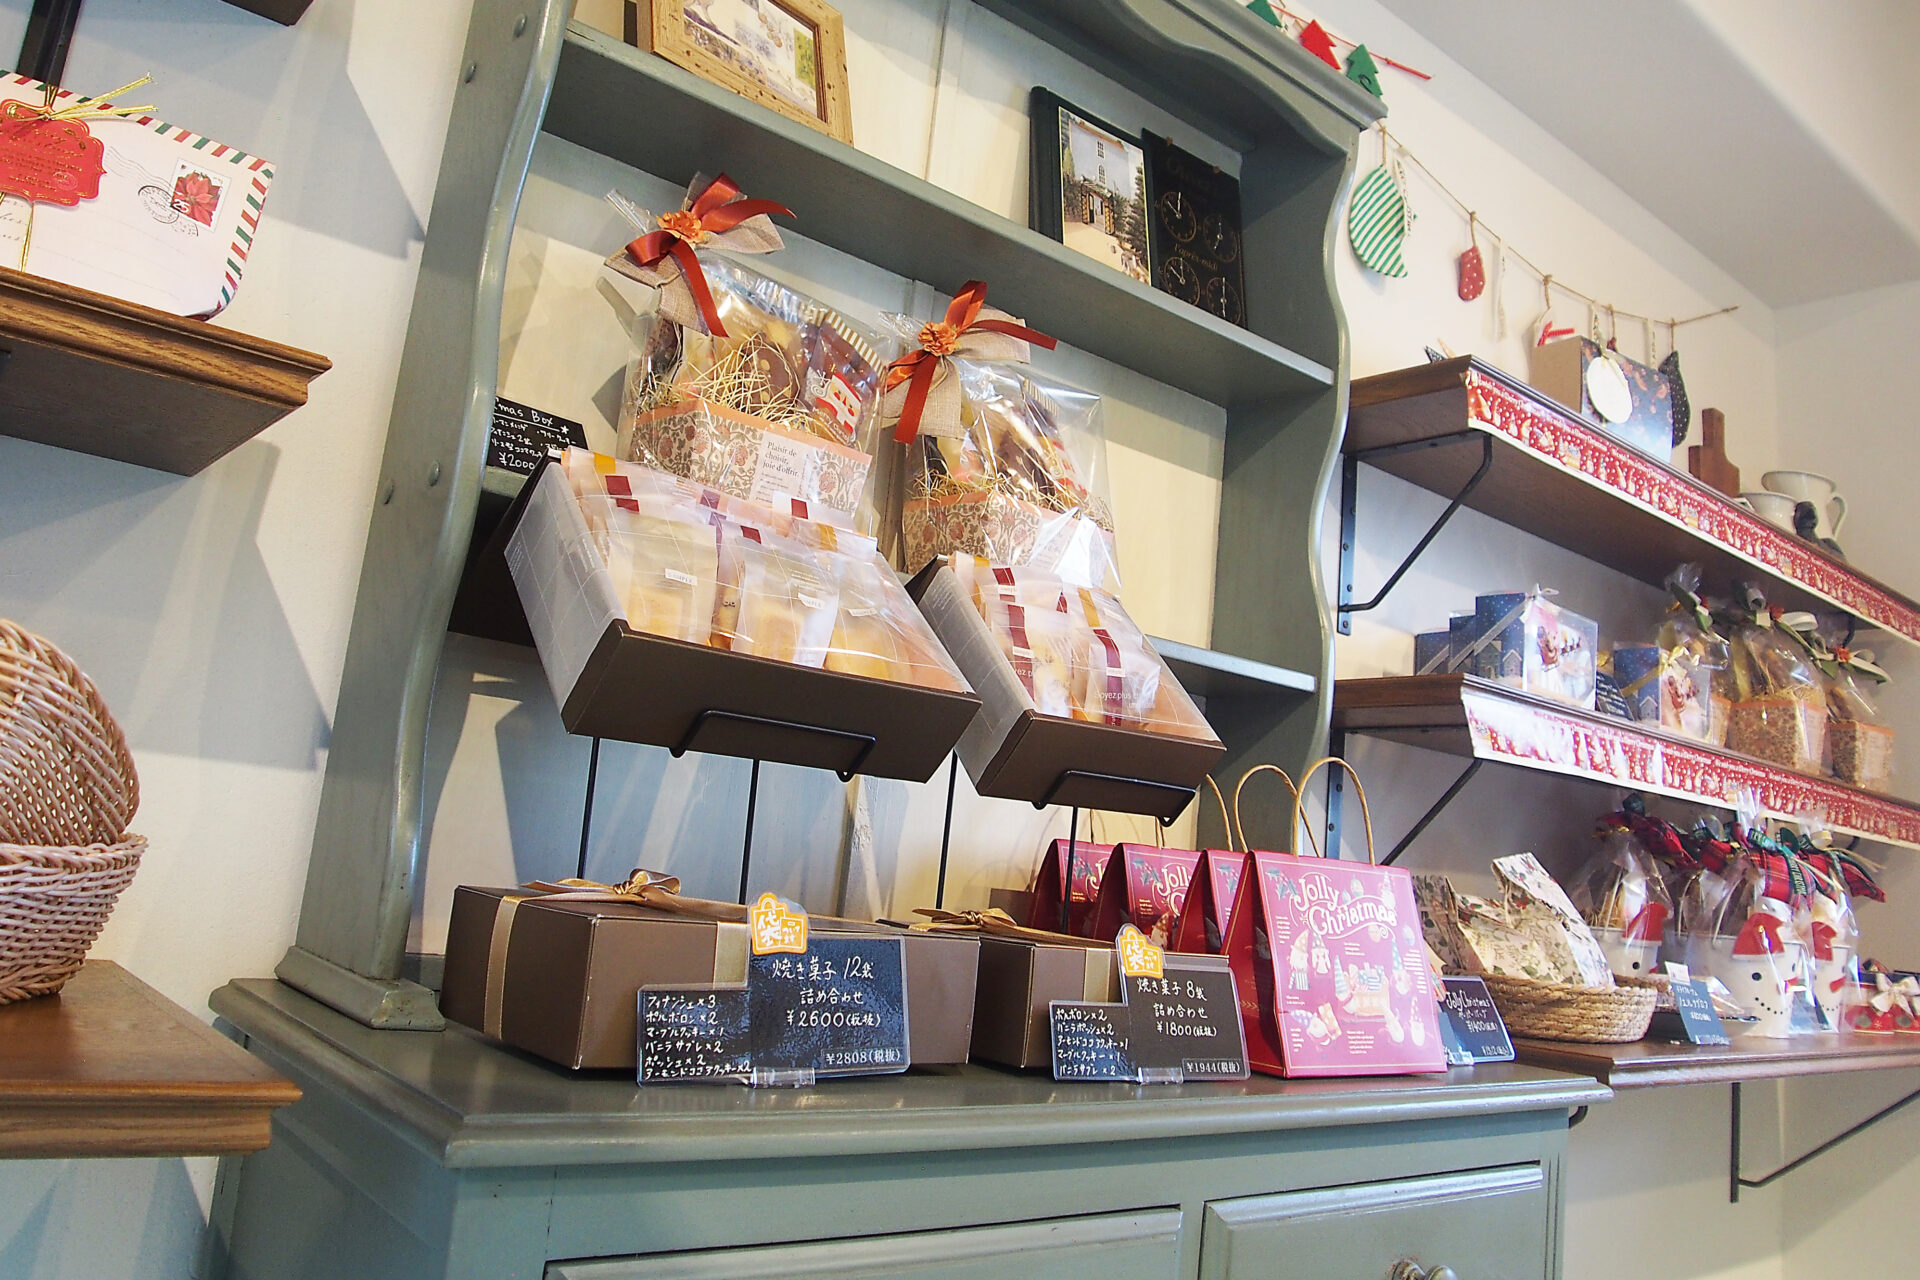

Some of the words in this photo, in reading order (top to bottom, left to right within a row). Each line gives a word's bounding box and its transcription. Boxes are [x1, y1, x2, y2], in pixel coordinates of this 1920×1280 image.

[173, 198, 190, 213] 25
[531, 409, 554, 427] Box
[767, 441, 788, 454] Plaisir
[788, 448, 798, 457] de
[762, 460, 776, 470] joie
[1157, 866, 1191, 896] Joll
[1294, 875, 1340, 911] Jolly
[1308, 901, 1398, 936] Christmas
[772, 956, 837, 981] 焼き菓子
[800, 987, 864, 1004] 詰め合わせ
[1137, 978, 1182, 996] 焼き菓子
[1153, 1002, 1208, 1019] 詰め合わせ
